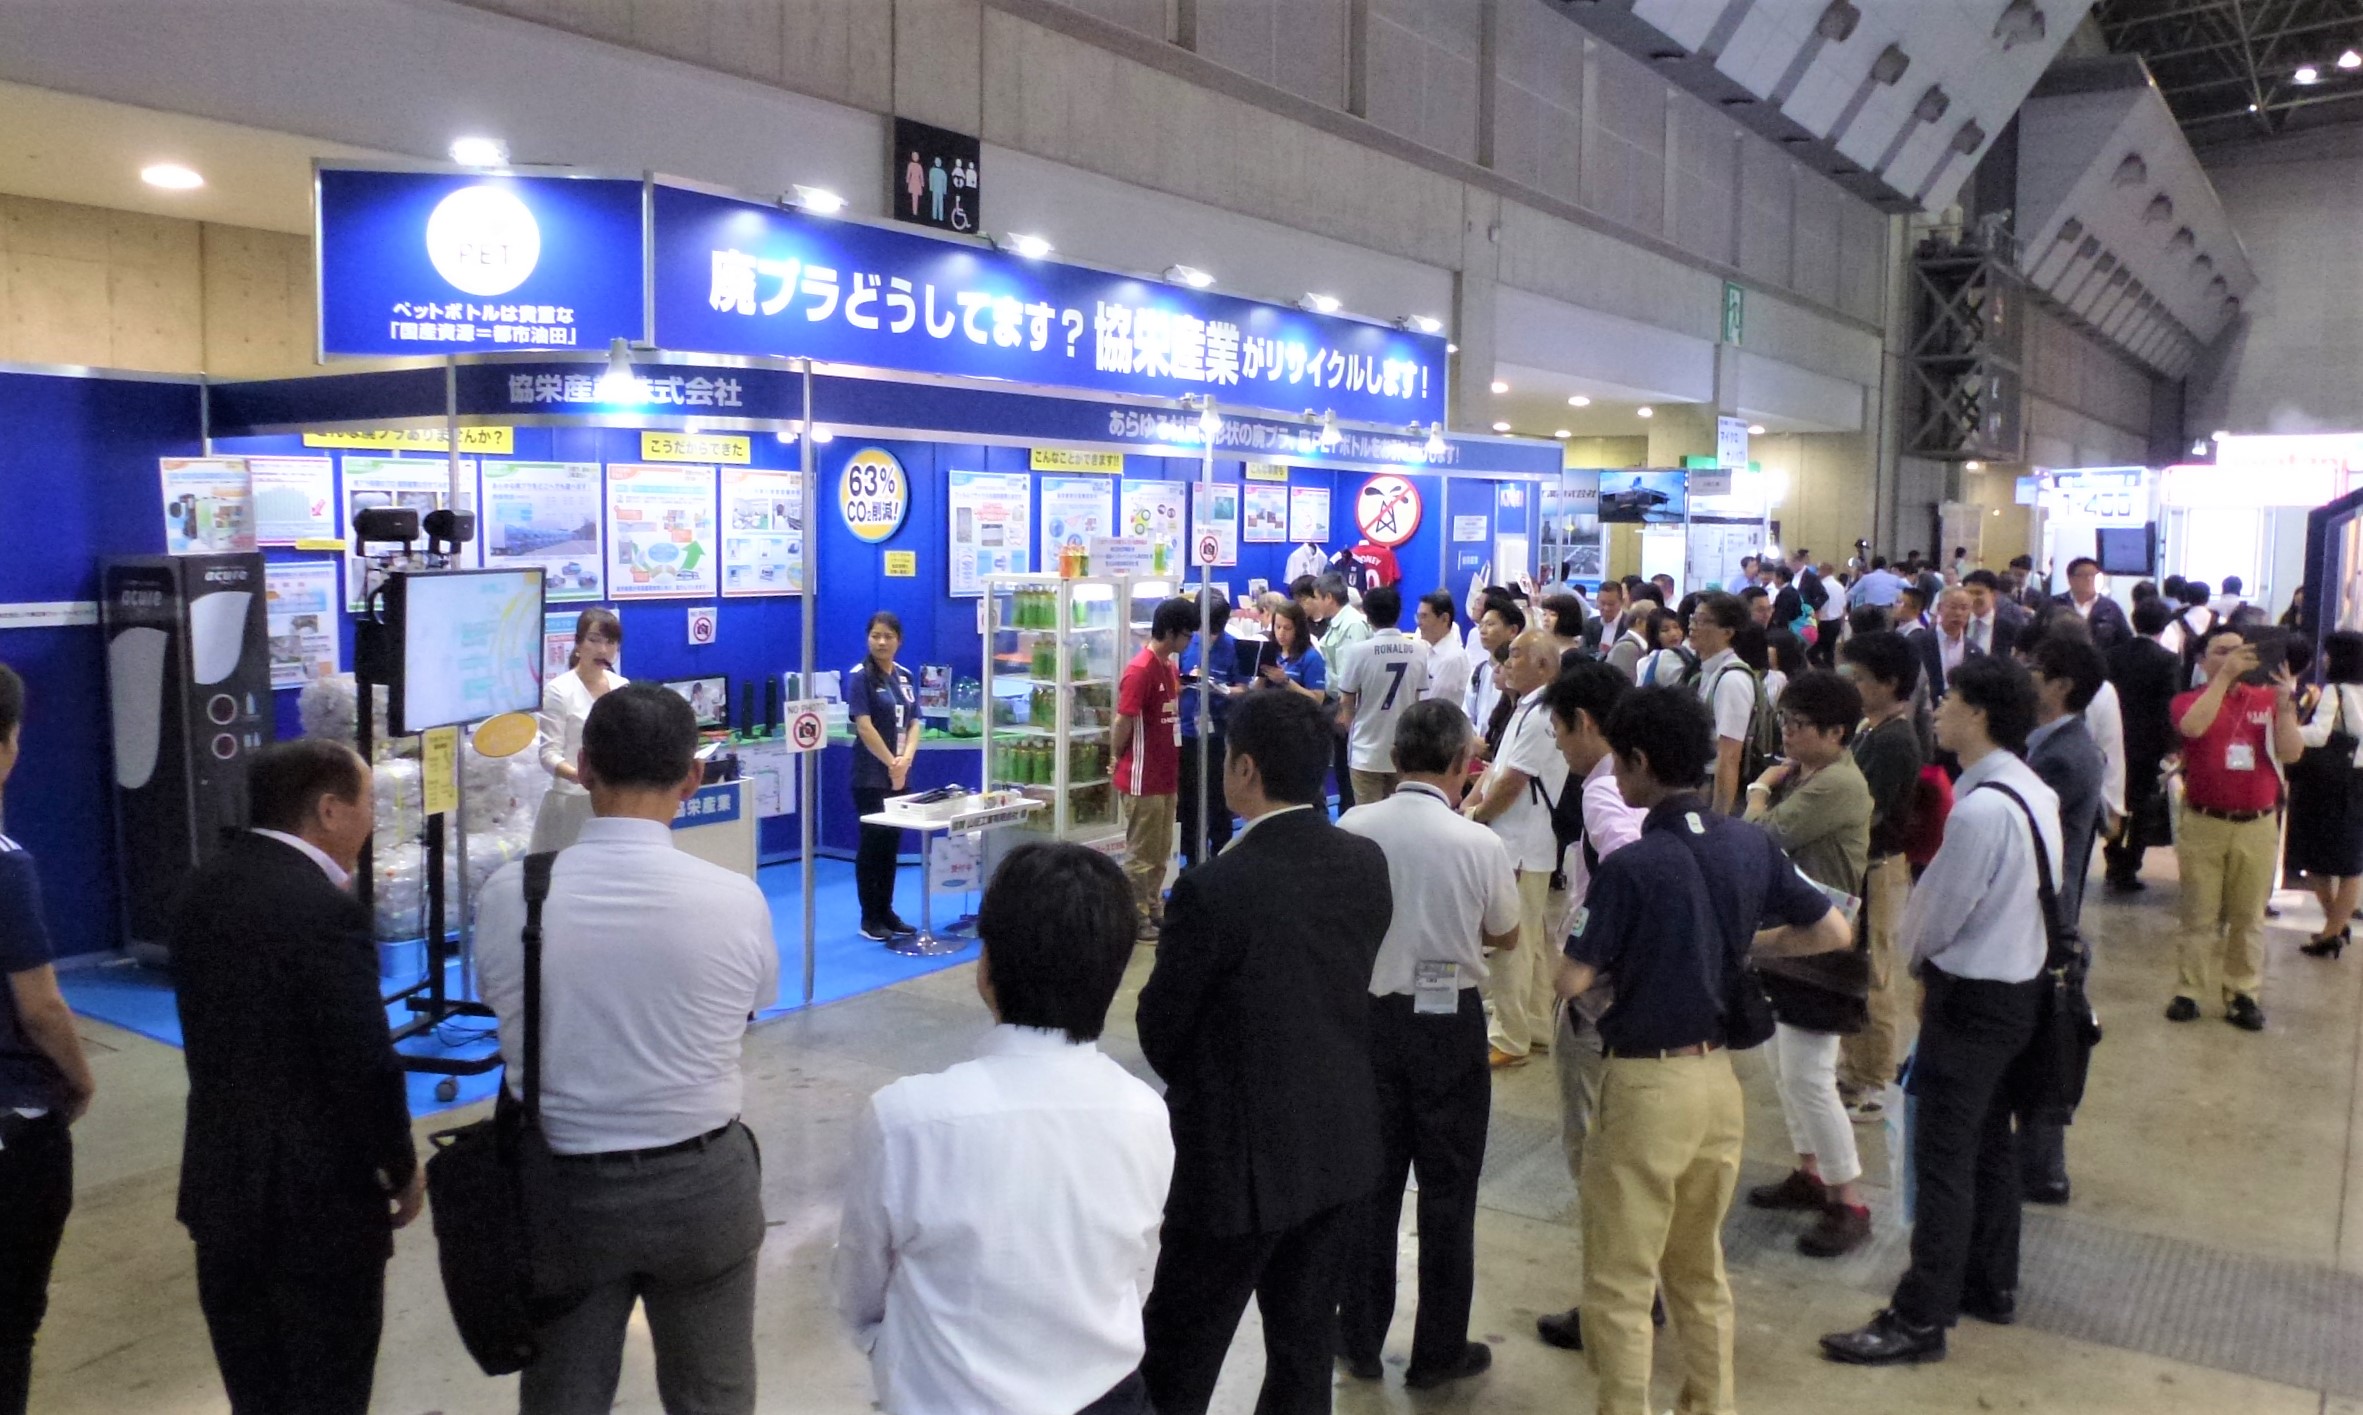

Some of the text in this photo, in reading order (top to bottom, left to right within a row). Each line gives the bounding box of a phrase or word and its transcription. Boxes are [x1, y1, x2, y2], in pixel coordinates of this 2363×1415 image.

[393, 302, 574, 324] ペットボトルは貴重な
[509, 373, 743, 407] 協栄産式会社
[849, 465, 895, 497] 63%
[204, 570, 248, 581] acure
[1374, 644, 1414, 655] RONALDO
[1381, 662, 1408, 711] 7
[788, 703, 826, 714] NO PHOTO
